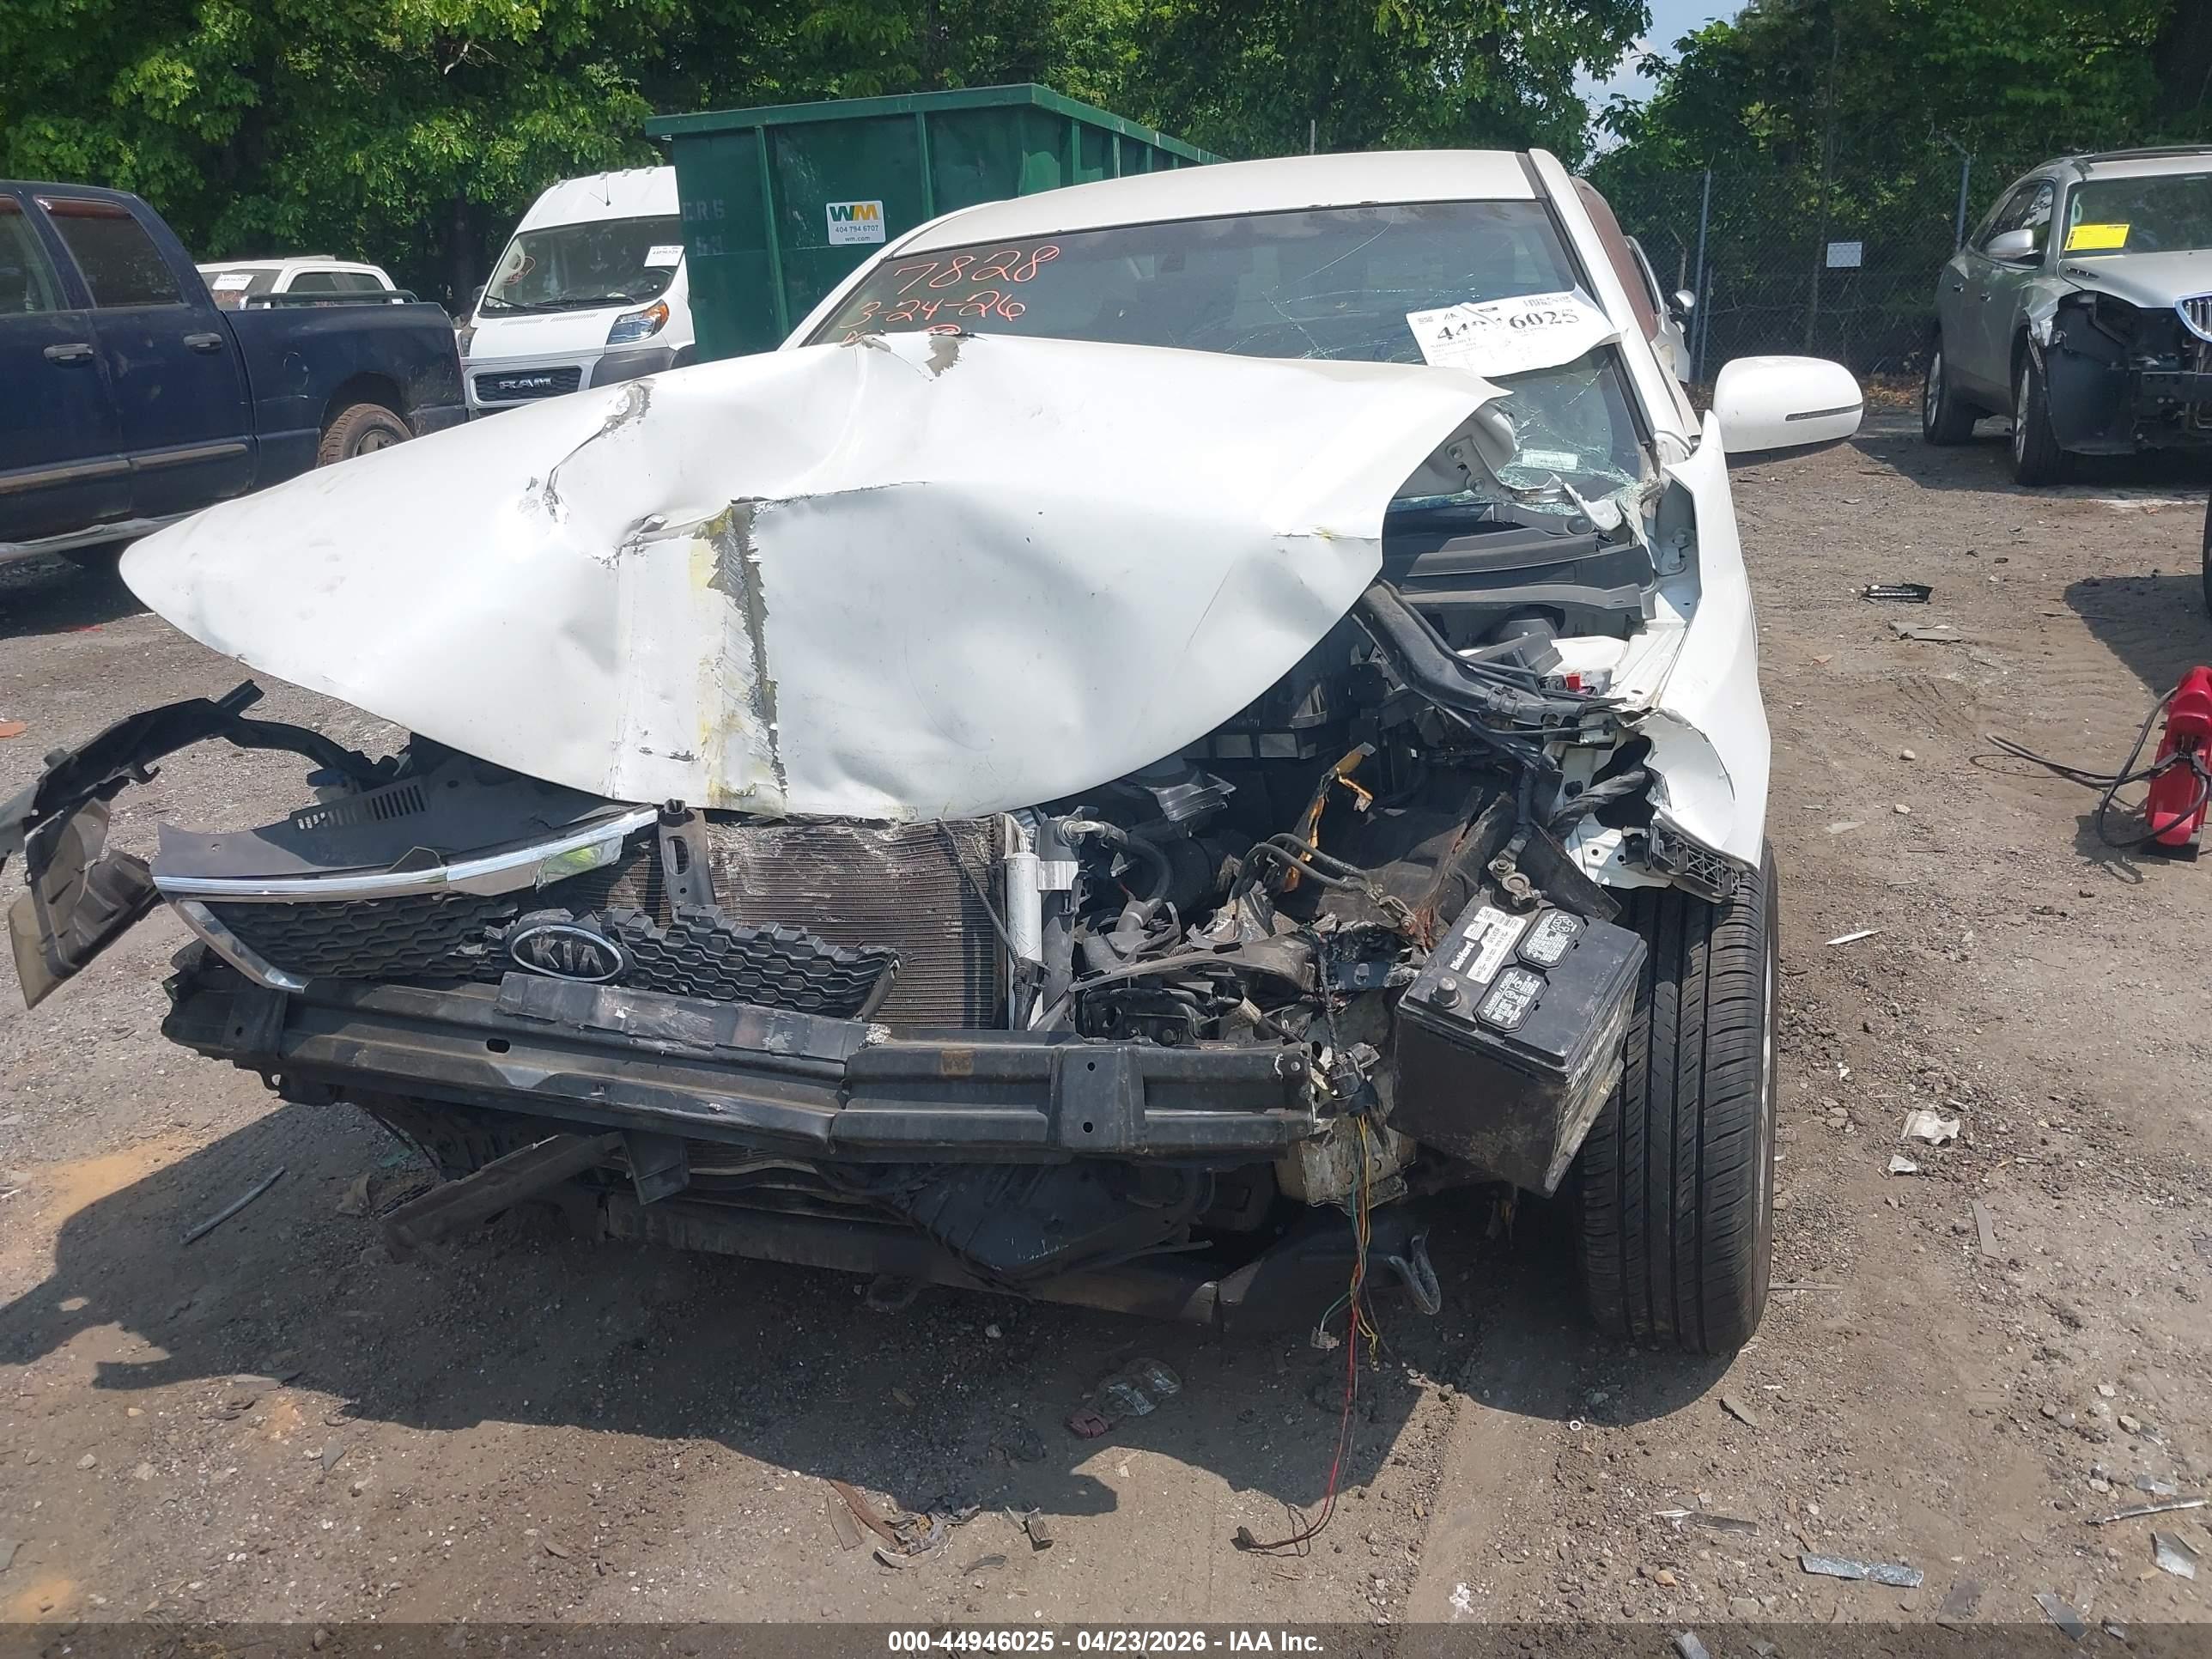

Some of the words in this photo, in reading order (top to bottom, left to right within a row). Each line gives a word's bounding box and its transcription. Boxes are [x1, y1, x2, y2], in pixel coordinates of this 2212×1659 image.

[829, 204, 879, 222] WM
[894, 245, 1060, 295] 7828
[839, 289, 1026, 330] 3-24-26
[499, 378, 553, 390] RAM
[529, 936, 605, 975] KIA
[1449, 940, 1475, 971] DieHard
[1499, 971, 1515, 989] POISON
